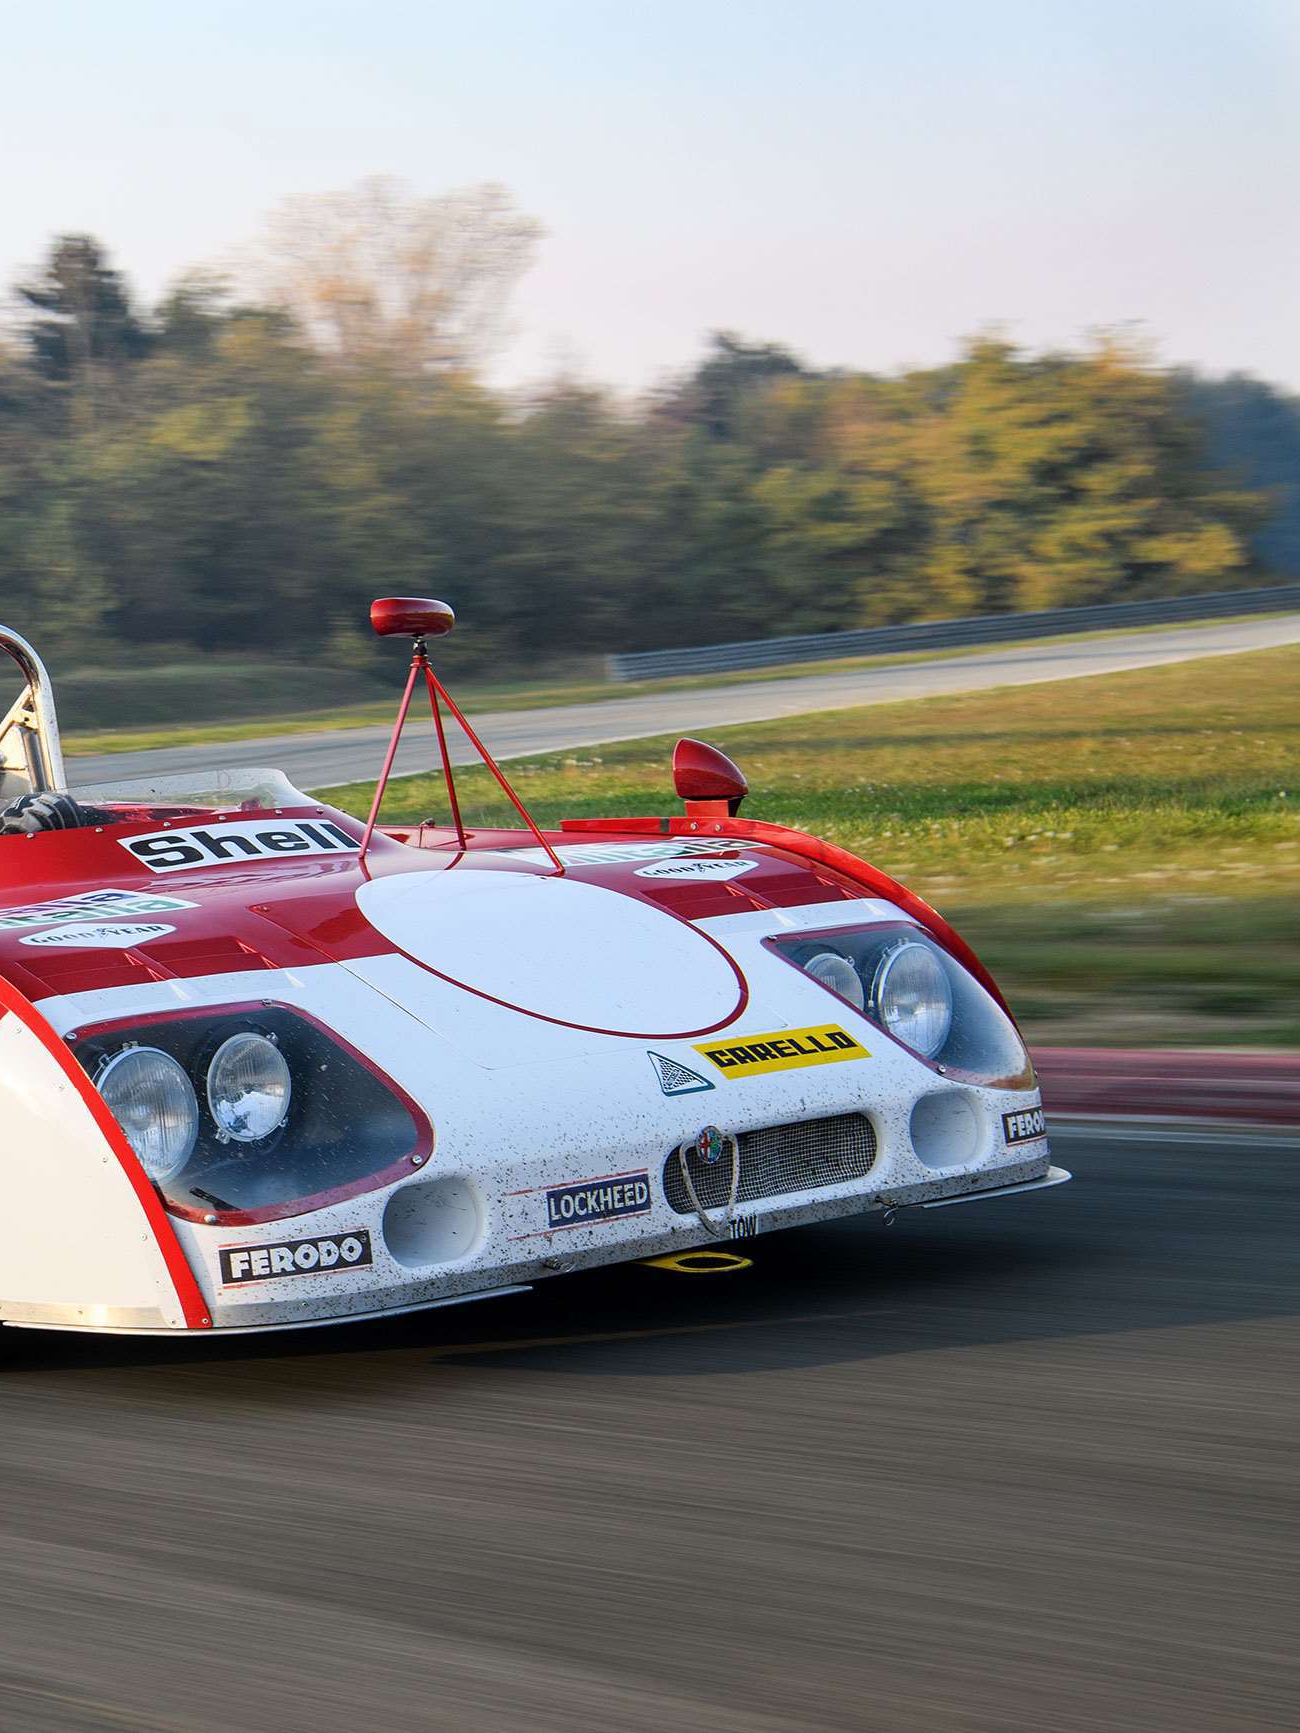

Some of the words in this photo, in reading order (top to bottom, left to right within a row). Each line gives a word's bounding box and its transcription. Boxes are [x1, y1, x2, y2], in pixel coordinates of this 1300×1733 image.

[129, 823, 361, 868] Shell
[105, 924, 166, 936] YEAR
[705, 1031, 858, 1068] CARELLO
[549, 1181, 648, 1220] LOCKHEED
[729, 1213, 757, 1239] TOW
[229, 1237, 363, 1278] FERODO
